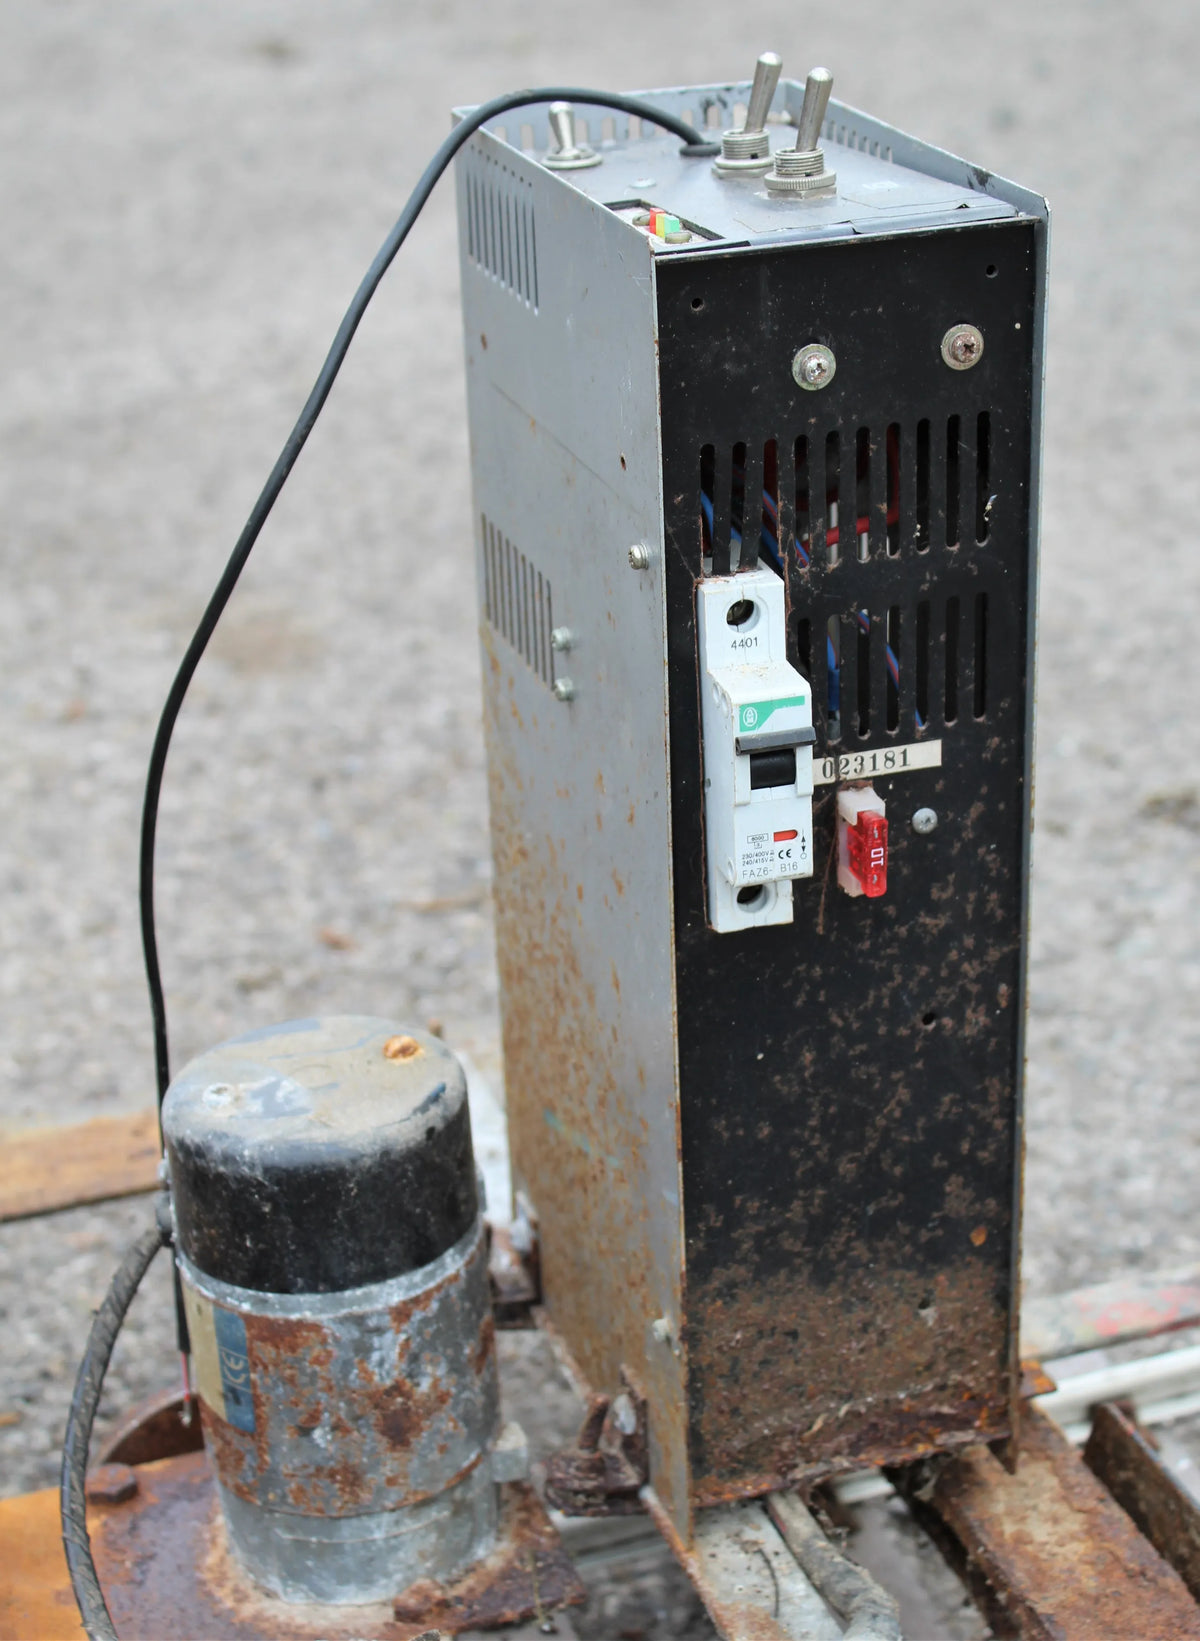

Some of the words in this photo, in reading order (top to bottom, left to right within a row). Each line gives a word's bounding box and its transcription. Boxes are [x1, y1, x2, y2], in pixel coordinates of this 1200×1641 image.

[731, 637, 759, 650] 4401
[822, 747, 911, 779] 023181
[871, 847, 884, 867] 10
[780, 862, 798, 873] B16
